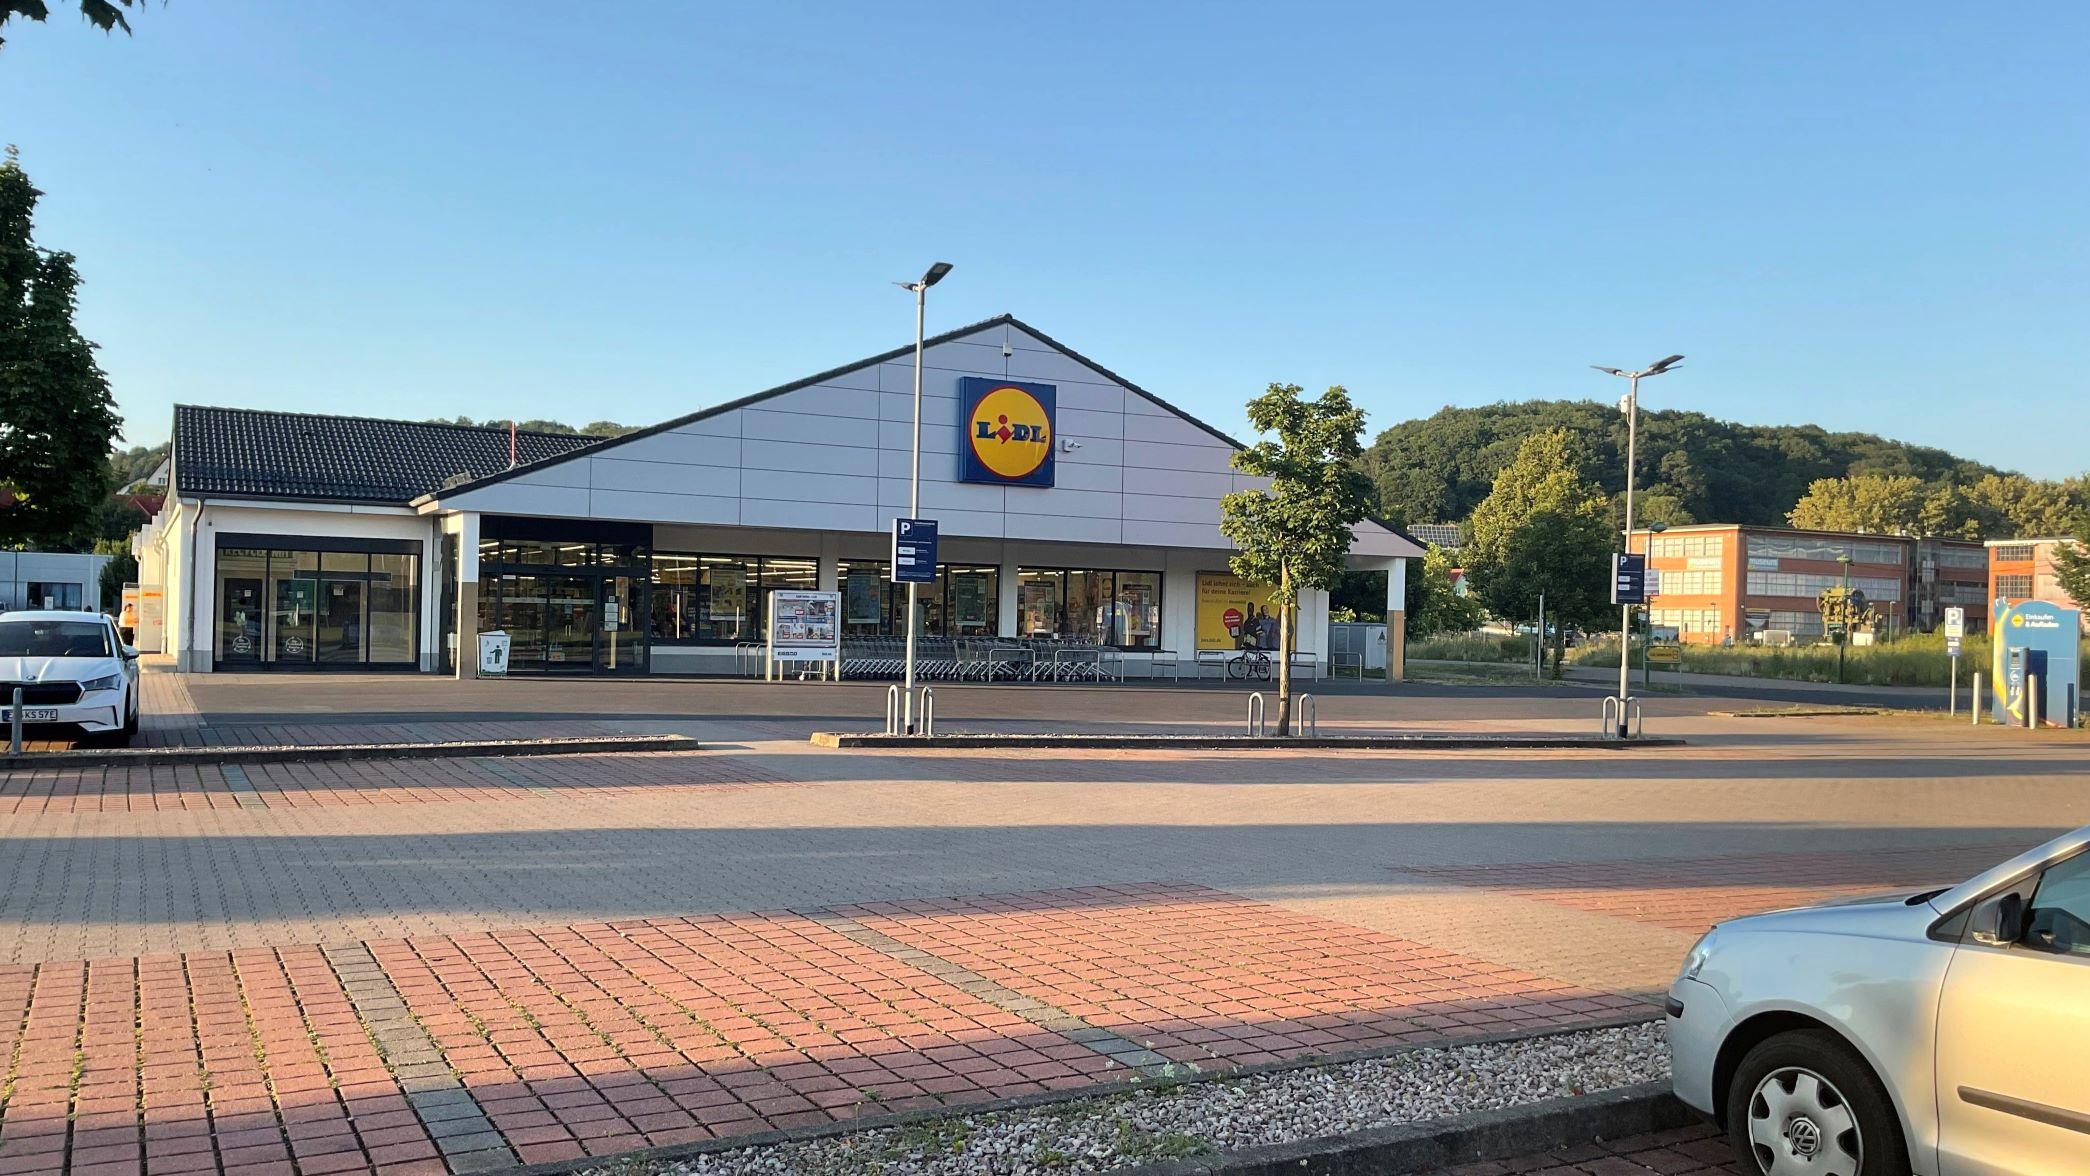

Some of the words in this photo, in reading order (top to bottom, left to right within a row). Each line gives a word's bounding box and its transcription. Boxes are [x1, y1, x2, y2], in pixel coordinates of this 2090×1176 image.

[901, 522, 910, 535] P
[1620, 556, 1627, 566] P
[1948, 610, 1959, 624] P
[25, 711, 36, 719] KS
